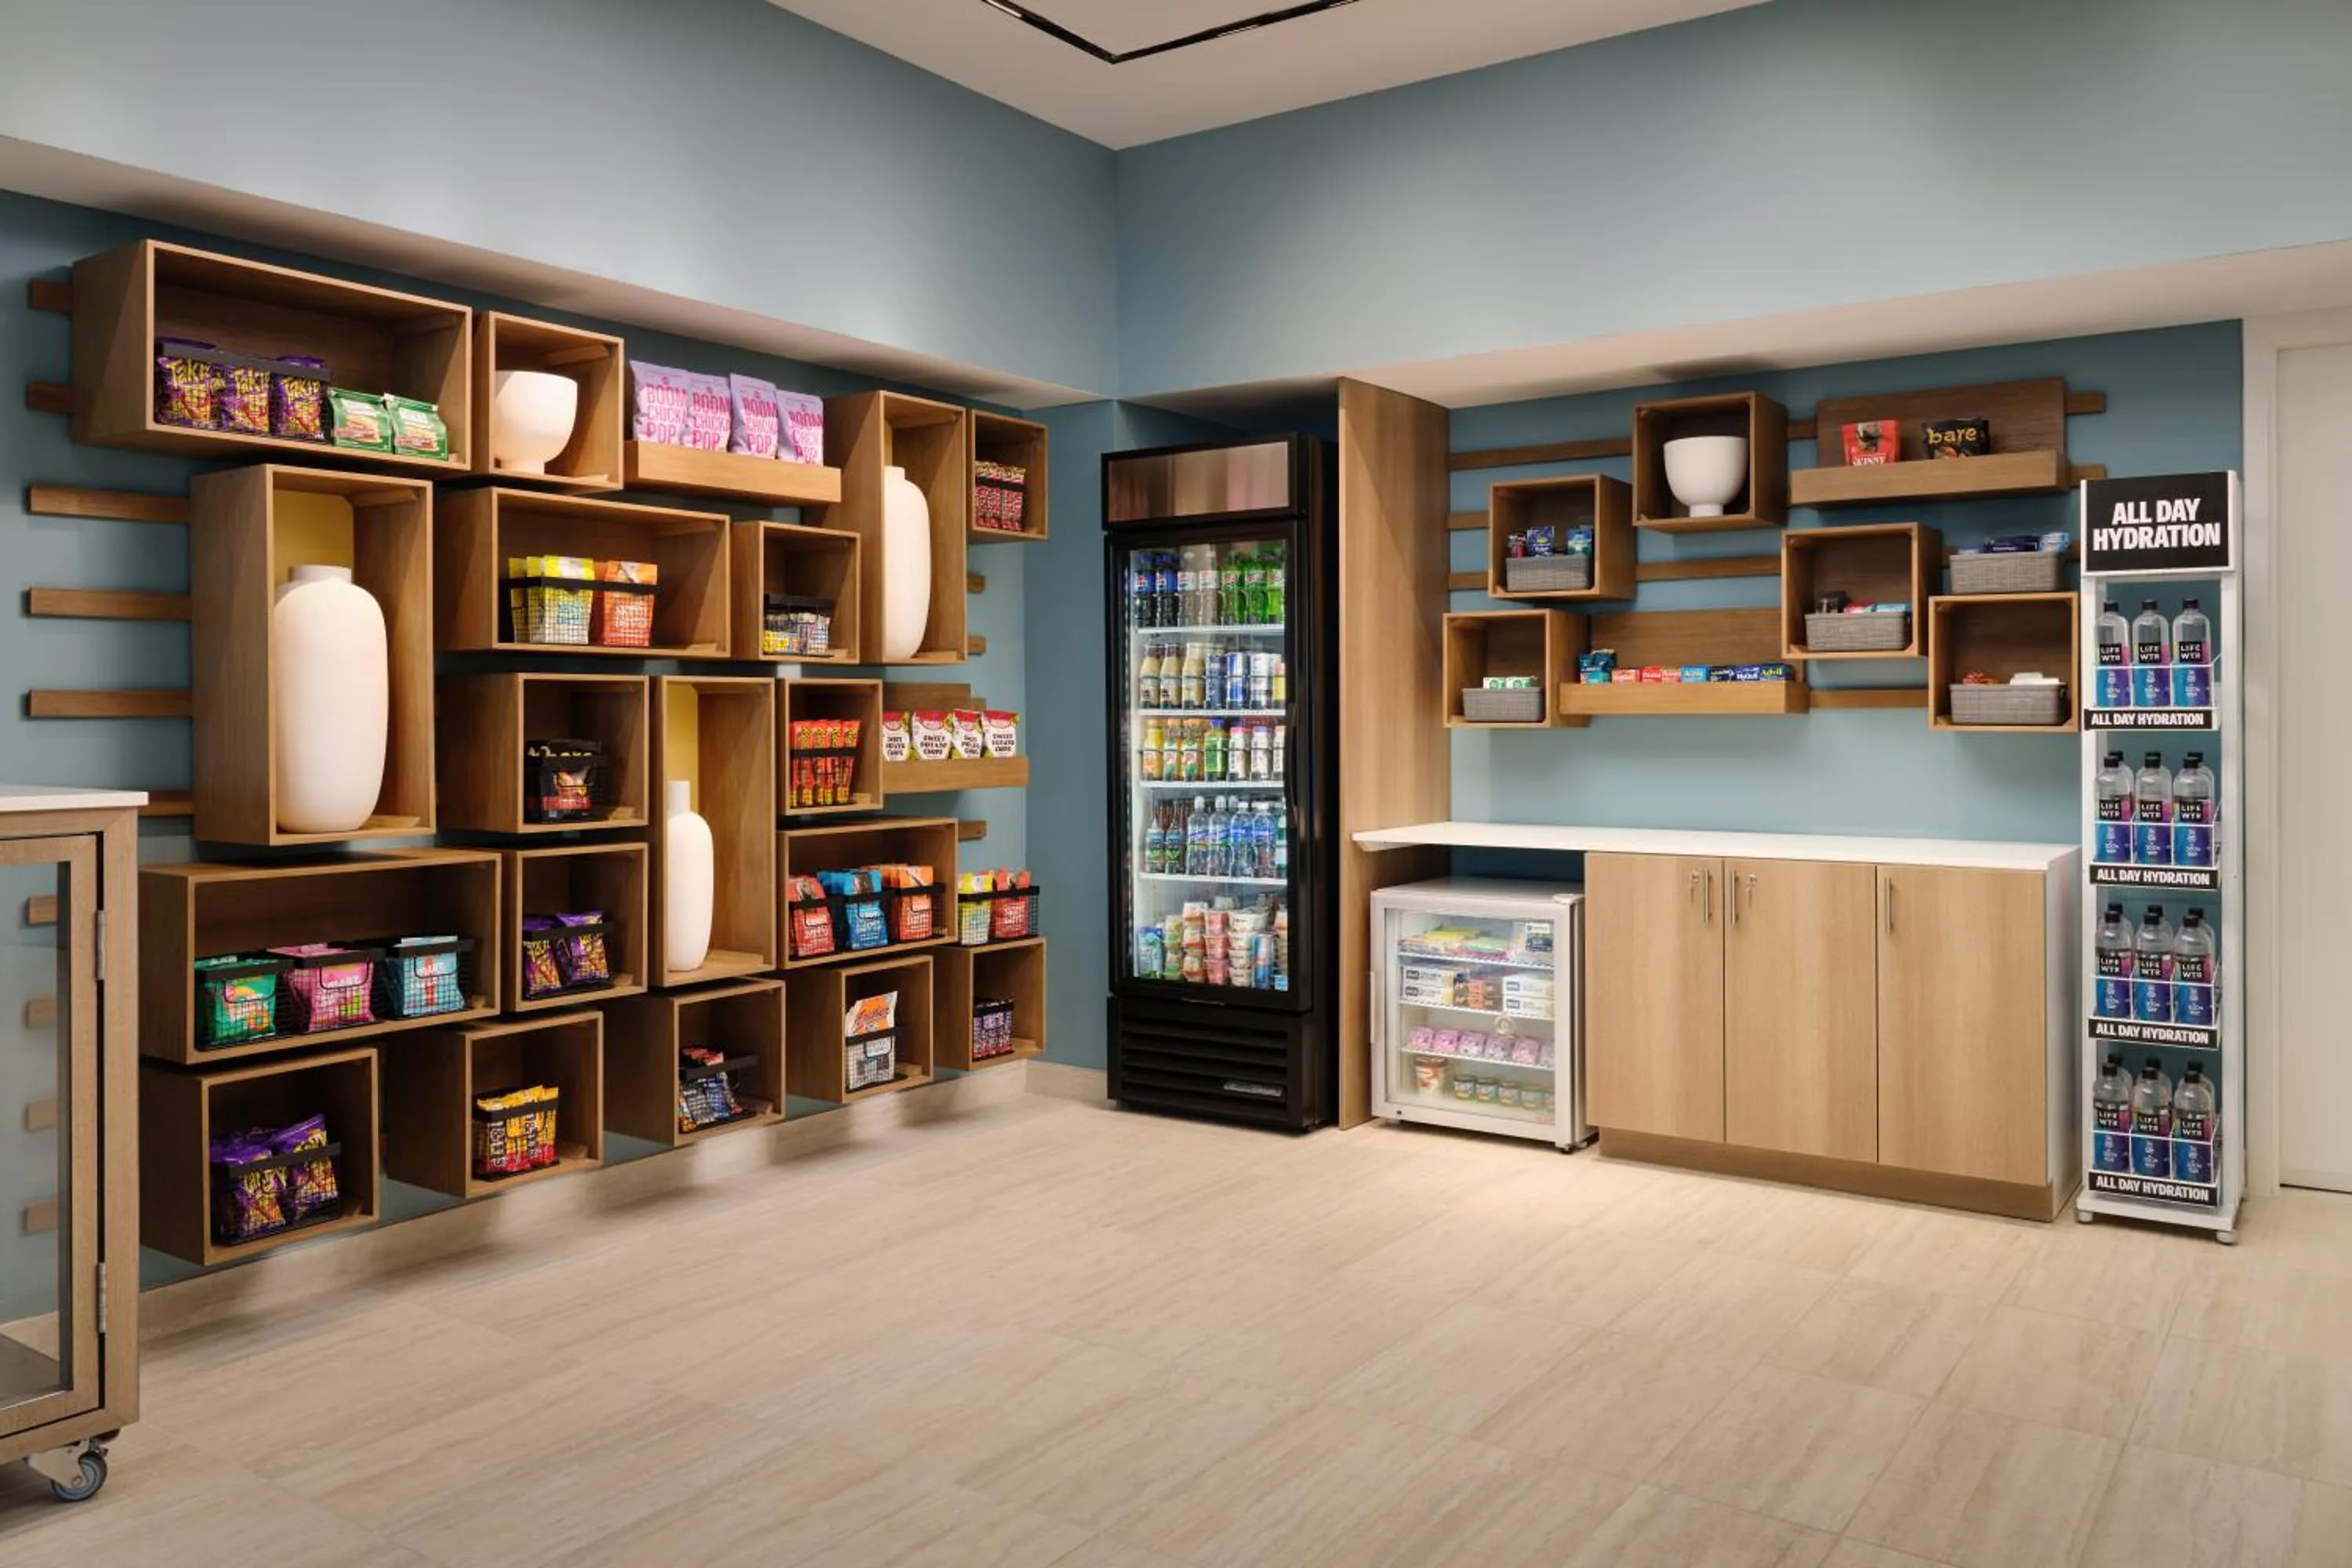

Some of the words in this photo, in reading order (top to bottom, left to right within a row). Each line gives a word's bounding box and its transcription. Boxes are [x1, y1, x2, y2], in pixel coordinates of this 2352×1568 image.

[647, 383, 688, 405] BOOM
[648, 405, 687, 425] CHICKA
[647, 422, 676, 444] POP
[692, 430, 720, 451] POP
[1927, 427, 1977, 445] bare
[746, 434, 771, 454] POP
[2111, 501, 2152, 525] ALL
[2156, 498, 2201, 523] DAY
[2092, 522, 2221, 551] HYDRATION
[1762, 667, 1782, 676] Advil
[2091, 713, 2112, 725] ALL
[2113, 713, 2136, 725] DAY
[2137, 713, 2204, 725] HYDRATION
[2096, 868, 2118, 881] ALL
[2119, 869, 2142, 883] DAY
[2143, 870, 2210, 885] HYDRATION
[2096, 1022, 2116, 1036] ALL
[2118, 1025, 2141, 1038] DAY
[2142, 1026, 2209, 1044] HYDRATION
[2096, 1175, 2117, 1189] ALL
[2118, 1178, 2140, 1192] DAY
[2143, 1181, 2209, 1201] HYDRATION
